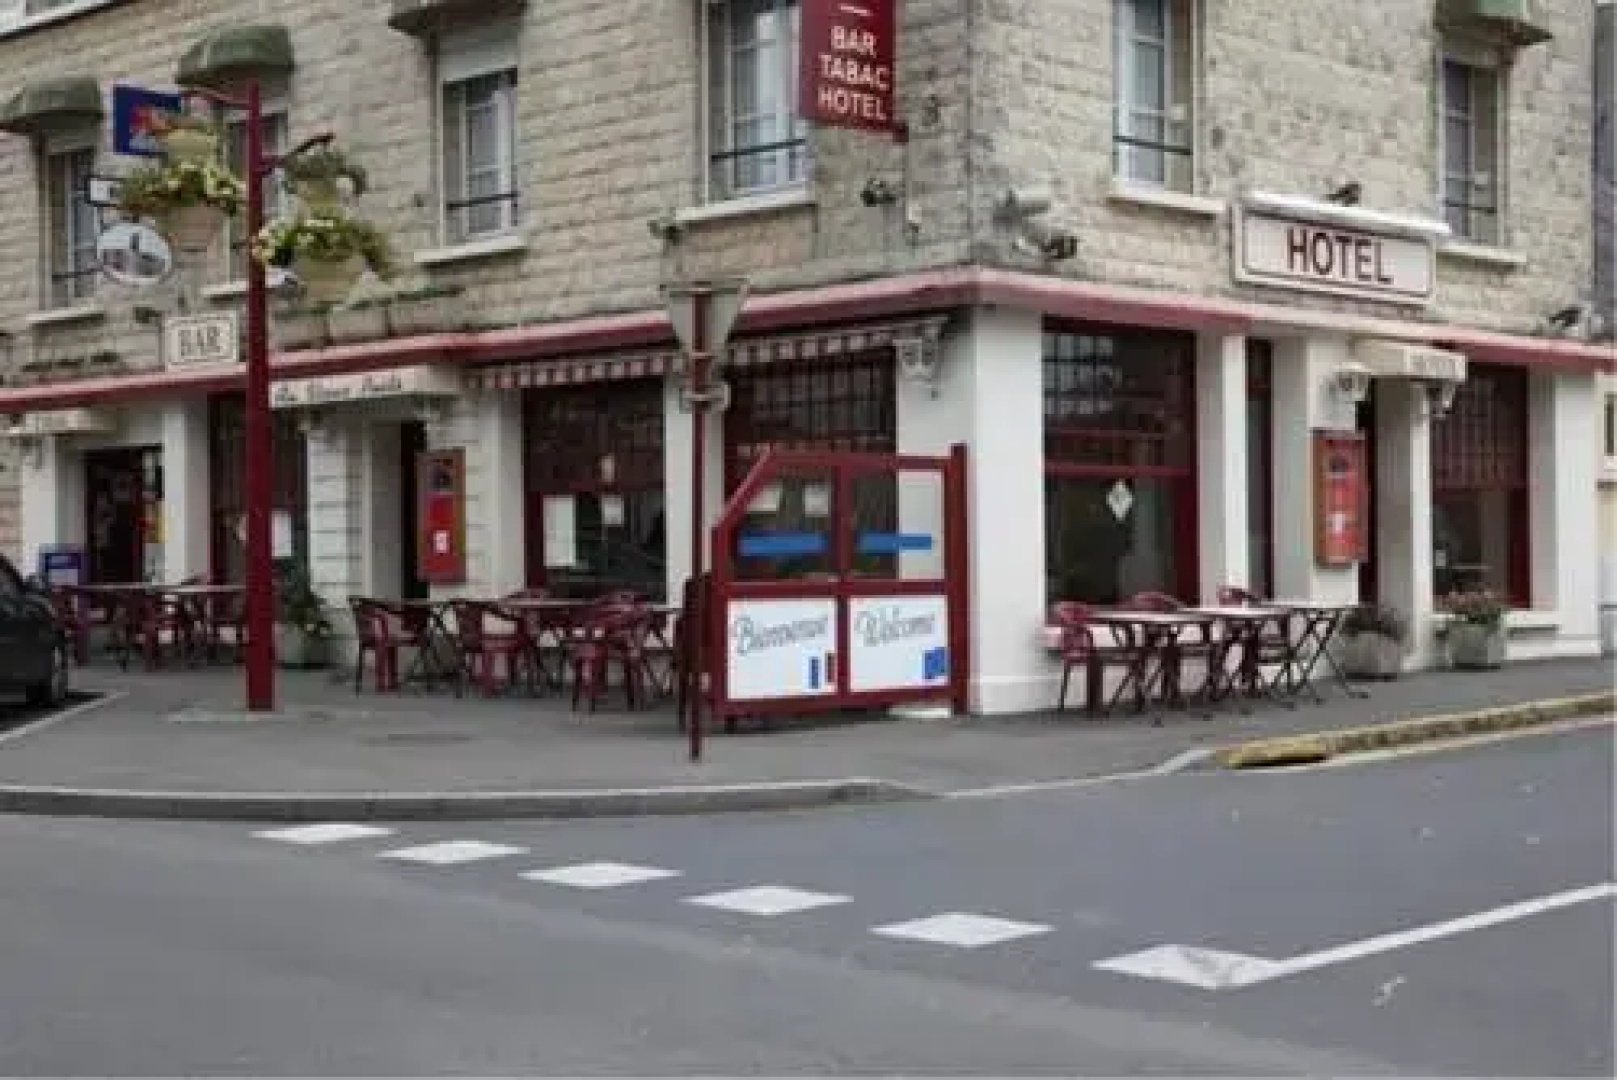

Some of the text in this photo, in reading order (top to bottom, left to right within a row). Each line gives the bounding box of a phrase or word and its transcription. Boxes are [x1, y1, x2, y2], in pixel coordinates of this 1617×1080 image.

[830, 25, 877, 57] BAR
[818, 52, 890, 91] TABAC
[817, 84, 887, 120] HOTEL
[1286, 227, 1394, 285] HOTEL
[178, 326, 221, 357] BAR
